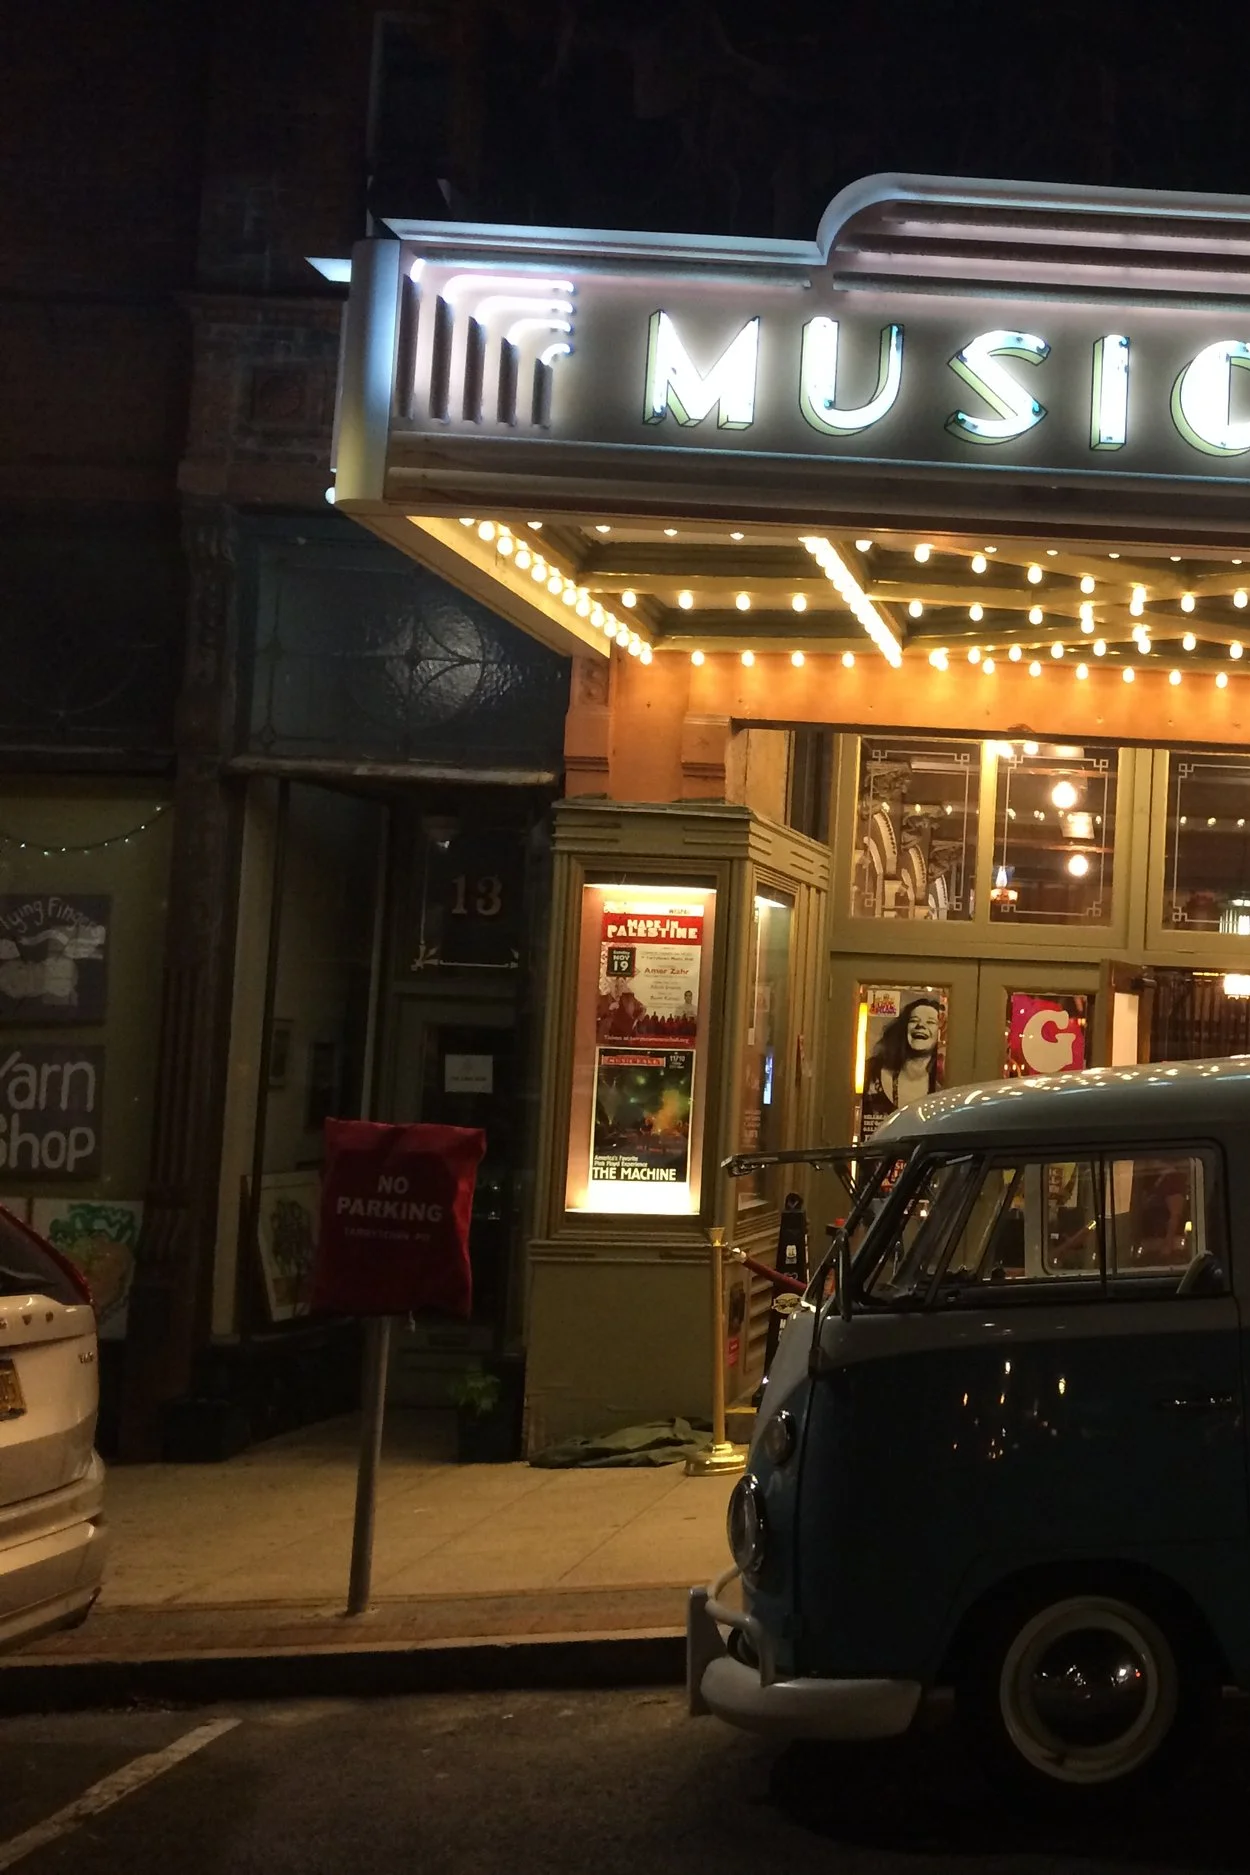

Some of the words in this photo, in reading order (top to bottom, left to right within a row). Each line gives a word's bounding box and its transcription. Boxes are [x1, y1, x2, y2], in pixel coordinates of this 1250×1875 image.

[450, 873, 503, 917] 13
[0, 900, 44, 934] lying
[627, 919, 661, 929] MADE
[666, 920, 680, 929] IN
[607, 925, 698, 939] PALESTINE
[613, 961, 629, 972] 19
[592, 1167, 617, 1180] THE
[620, 1167, 677, 1181] MACHINE
[376, 1173, 410, 1195] NO
[335, 1195, 444, 1223] PARKING
